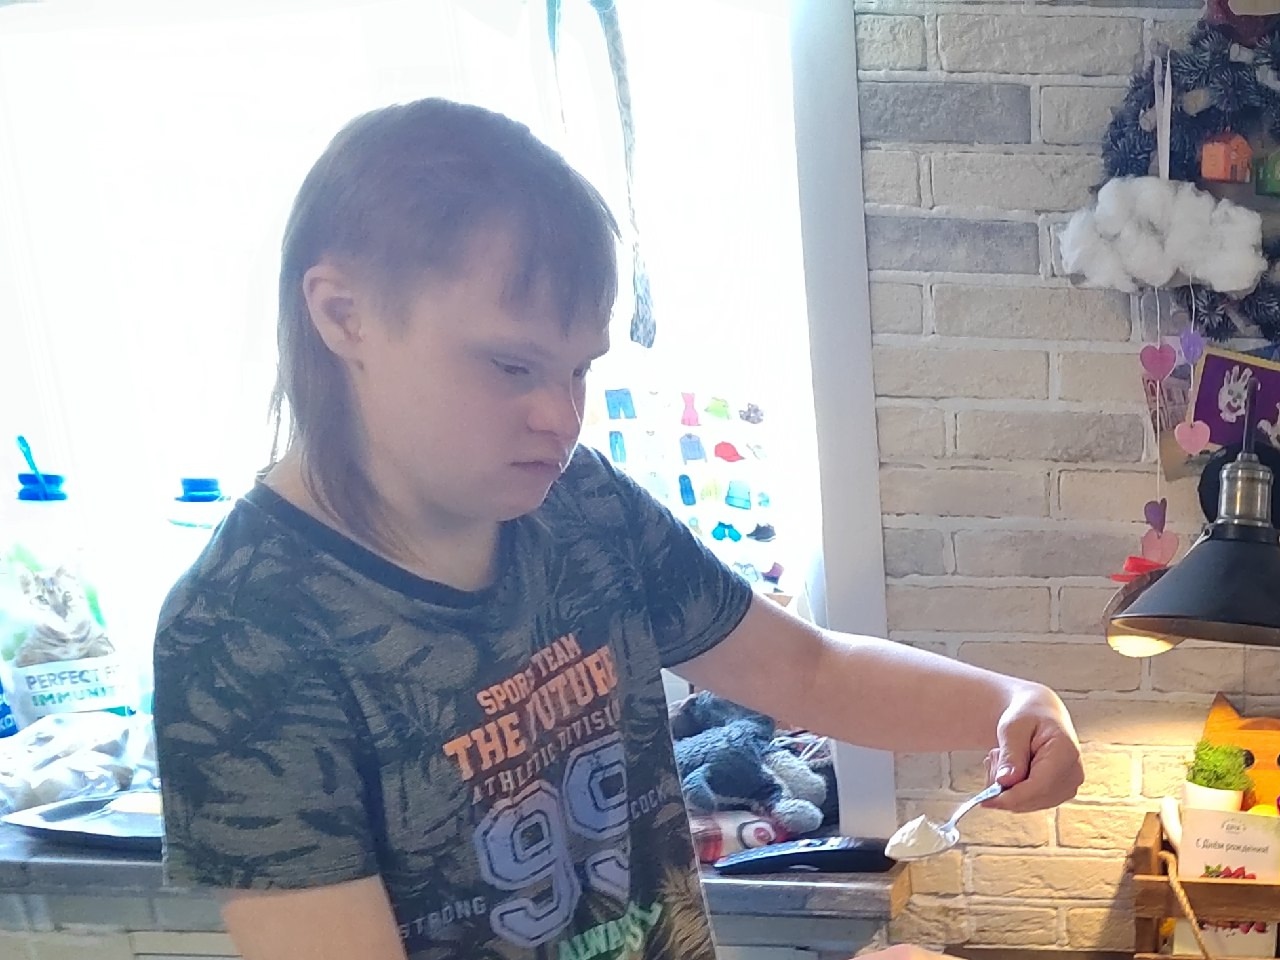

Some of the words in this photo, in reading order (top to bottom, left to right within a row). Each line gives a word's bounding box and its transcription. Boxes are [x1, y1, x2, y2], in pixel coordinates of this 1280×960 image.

[531, 632, 583, 674] TEAM
[25, 669, 99, 692] PERFECT
[442, 707, 527, 782] THE
